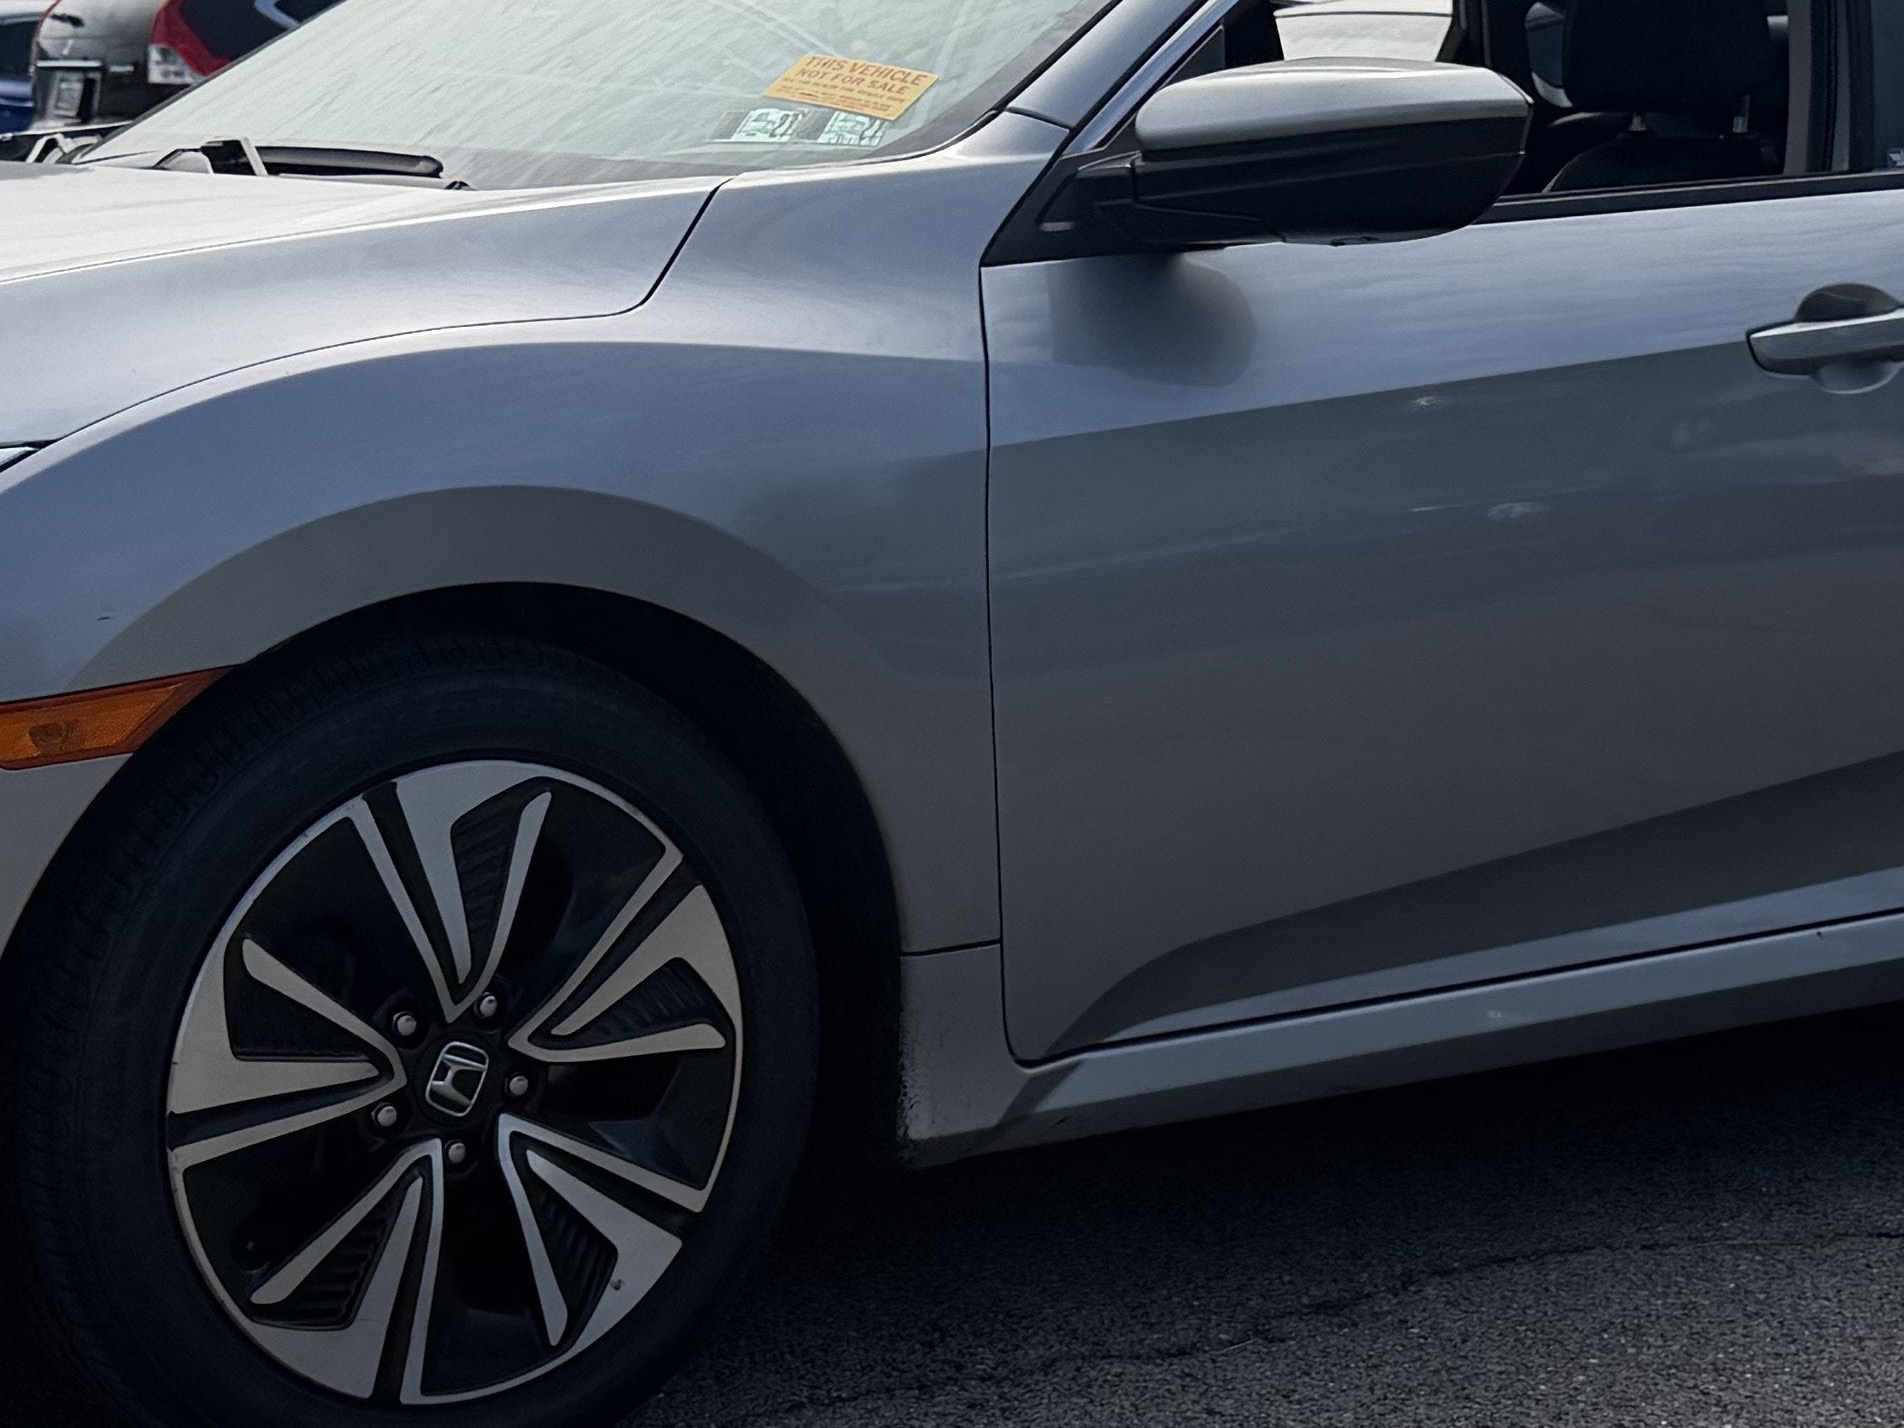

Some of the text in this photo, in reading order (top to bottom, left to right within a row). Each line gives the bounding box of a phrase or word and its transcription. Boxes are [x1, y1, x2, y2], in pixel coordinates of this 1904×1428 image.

[796, 68, 829, 80] NOT
[830, 73, 865, 85] FOR
[867, 80, 910, 94] SALE
[806, 56, 928, 86] THIS VEHICLE
